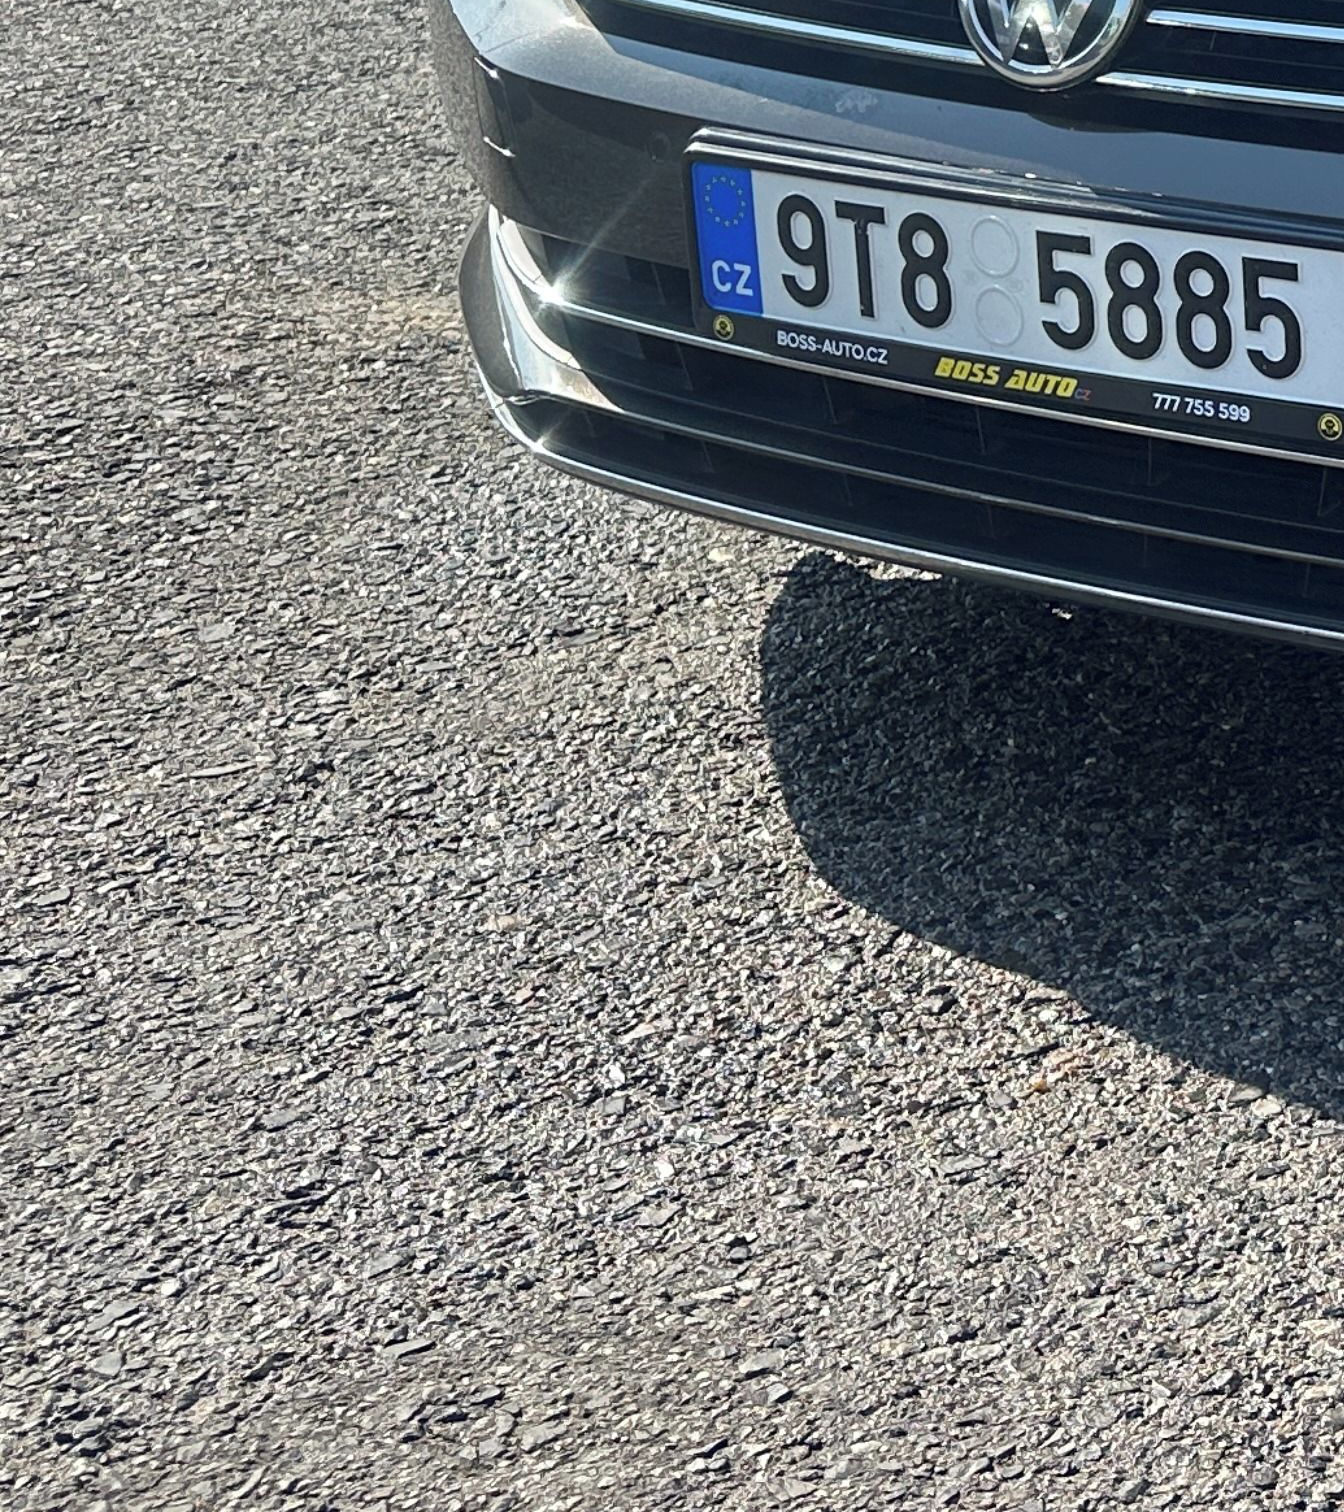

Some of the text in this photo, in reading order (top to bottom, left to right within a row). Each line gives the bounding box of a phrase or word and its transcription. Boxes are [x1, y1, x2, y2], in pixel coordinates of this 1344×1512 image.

[711, 259, 754, 297] CZ
[775, 193, 1304, 381] 9T8 5885
[776, 330, 888, 365] BOSS-AUTO.CZ
[934, 356, 1001, 386] BOSS
[1004, 368, 1078, 398] AUTO
[1152, 392, 1250, 423] 777 755 599
